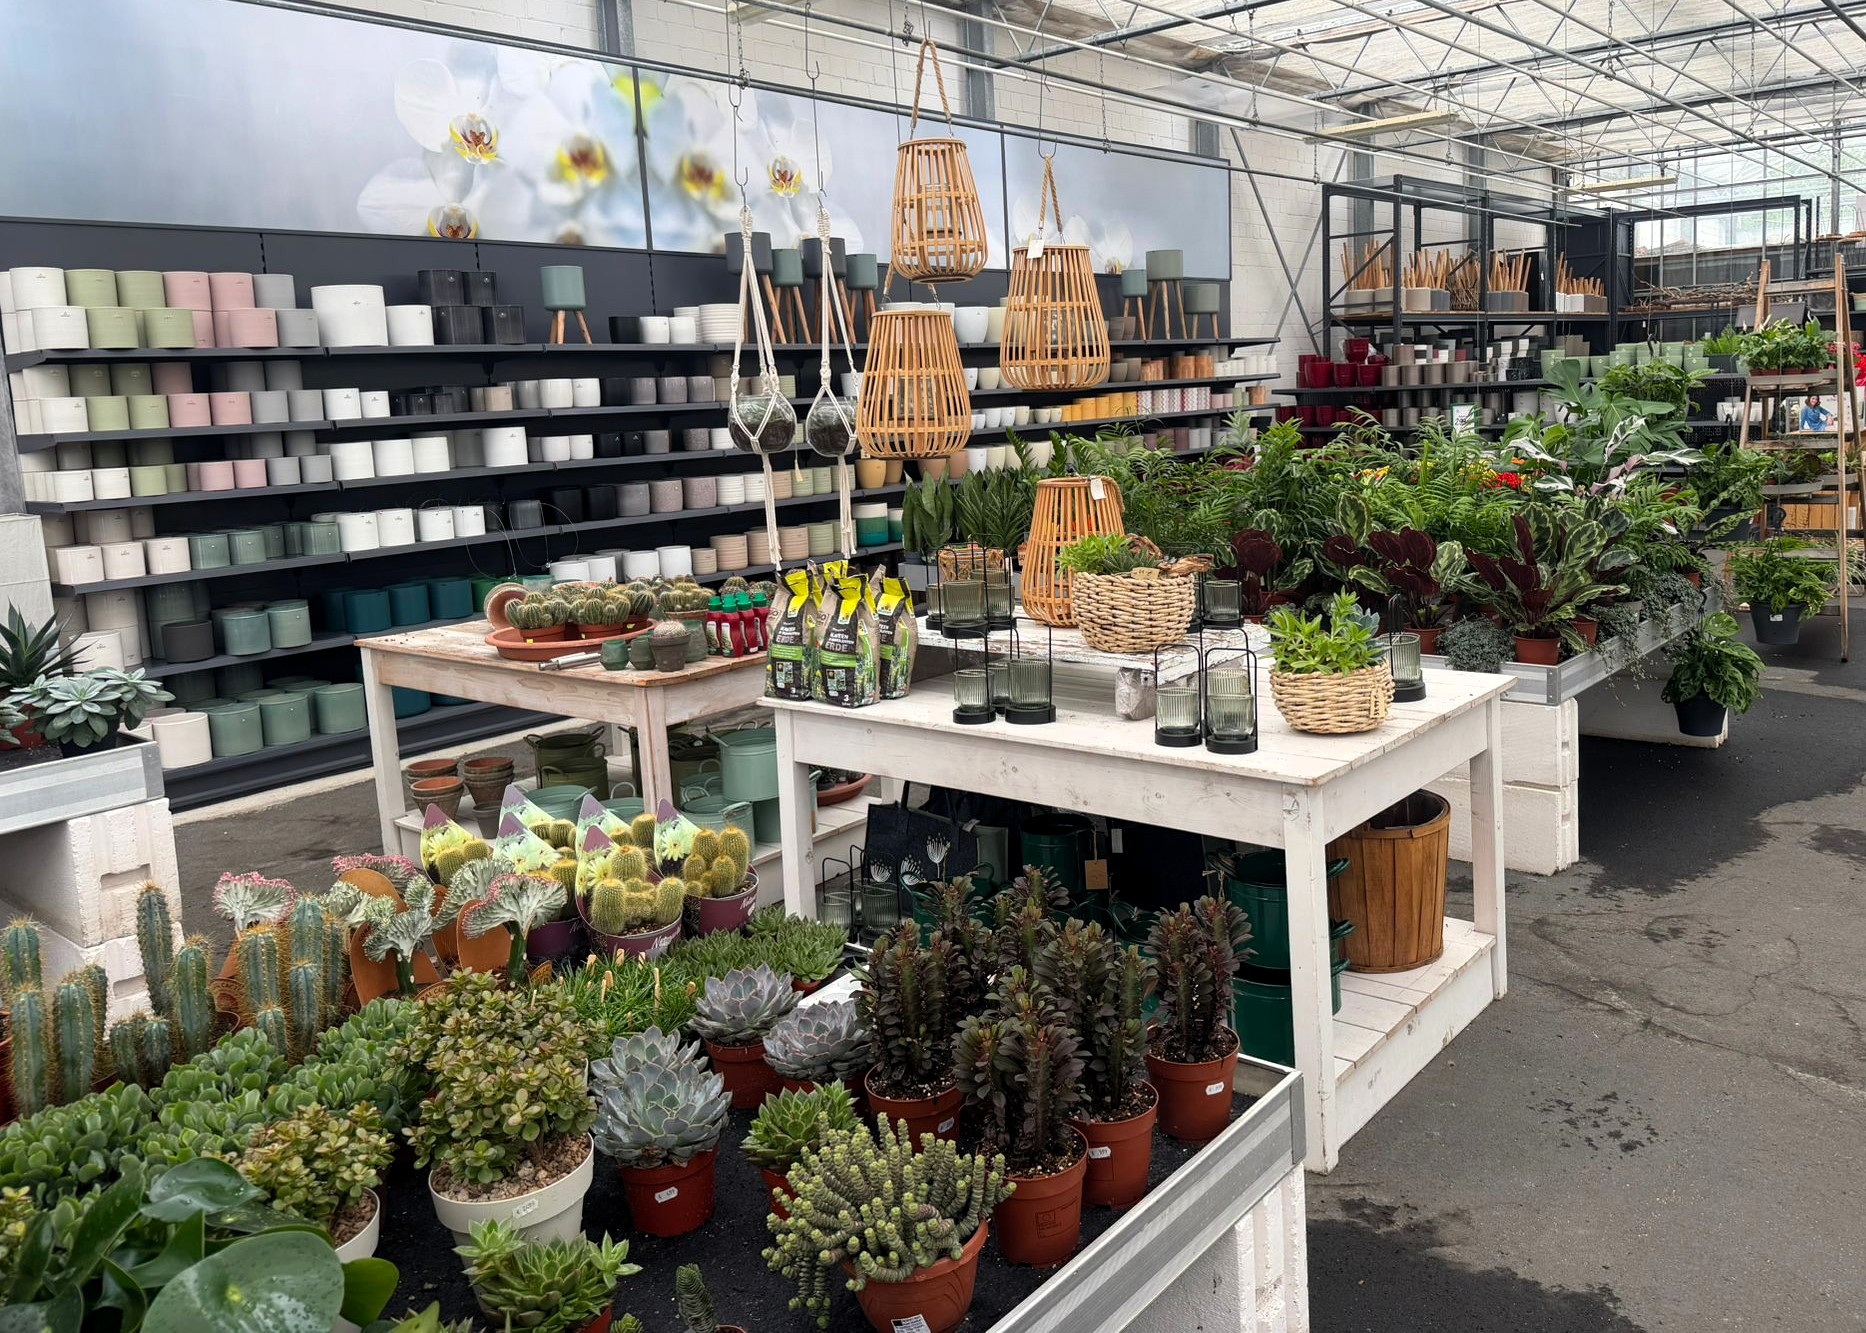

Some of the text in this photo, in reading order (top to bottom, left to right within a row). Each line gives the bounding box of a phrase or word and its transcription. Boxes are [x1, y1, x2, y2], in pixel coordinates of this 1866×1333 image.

[776, 635, 795, 644] ERDE
[825, 641, 848, 652] ERDE
[843, 694, 849, 702] 3
